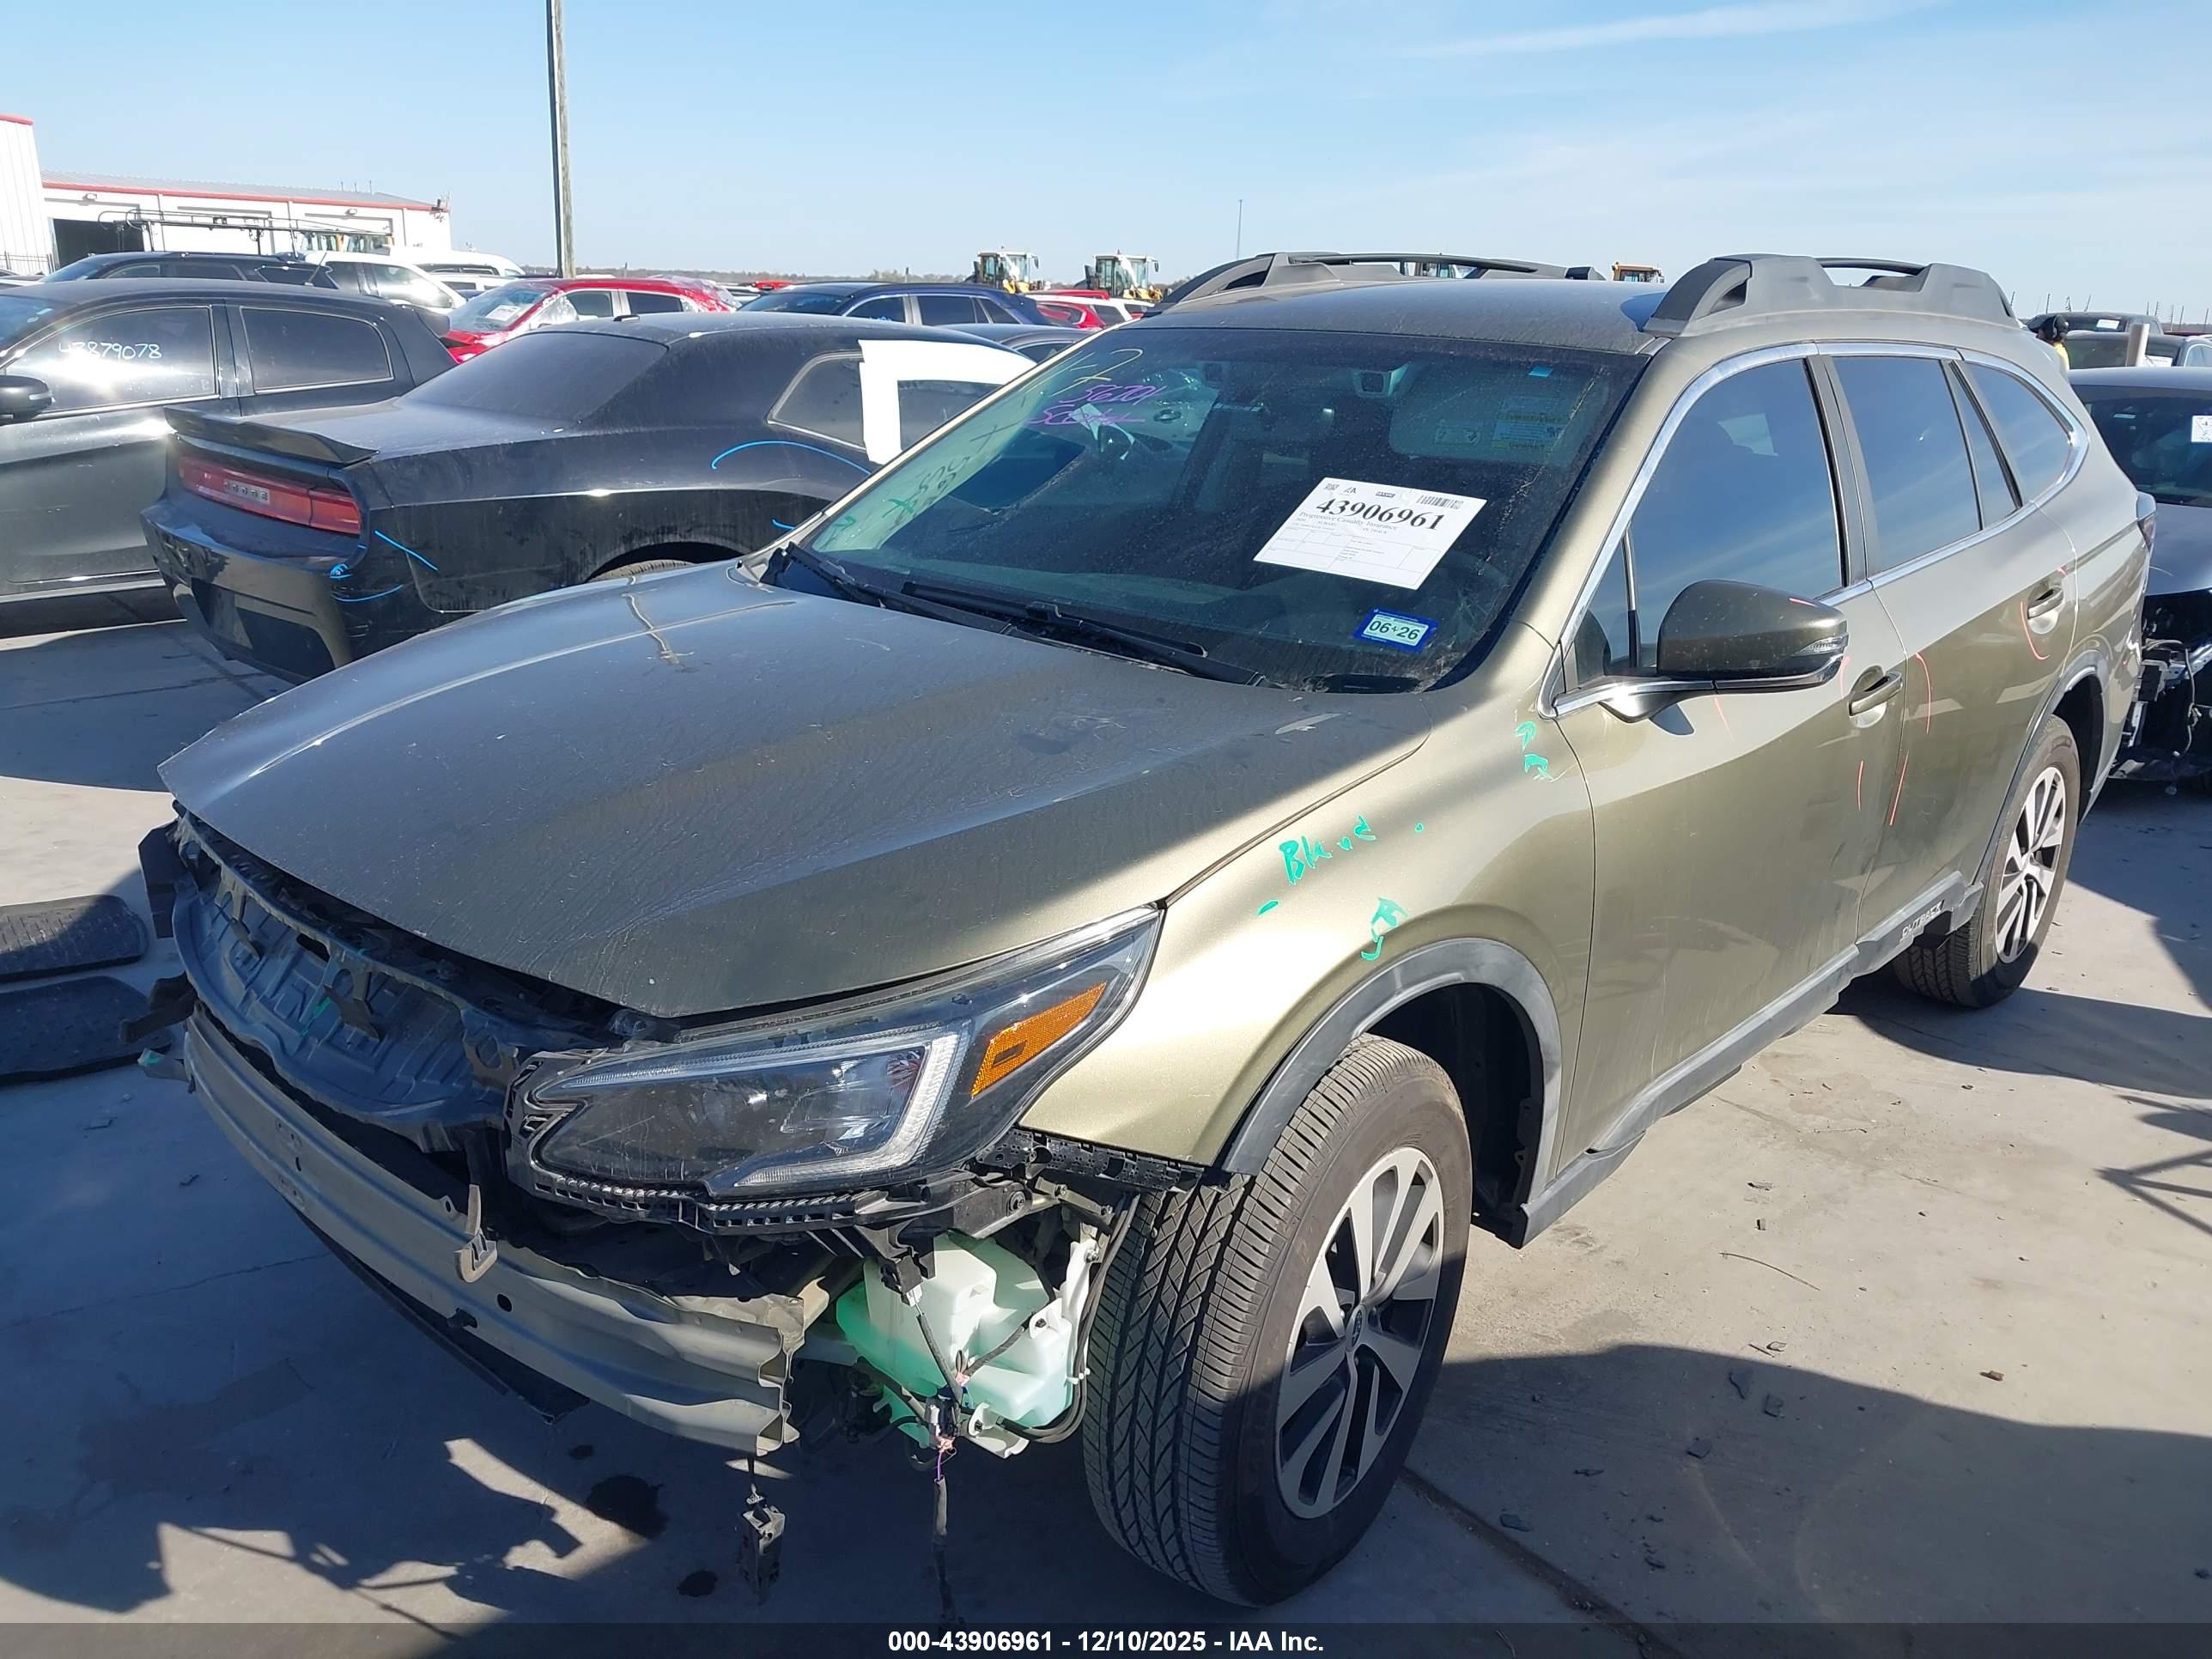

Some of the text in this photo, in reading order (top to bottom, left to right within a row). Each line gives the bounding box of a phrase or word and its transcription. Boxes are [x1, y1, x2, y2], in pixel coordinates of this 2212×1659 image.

[1299, 512, 1336, 522] Progressive
[1336, 517, 1364, 526] Casualty
[1364, 520, 1398, 532] Insurance
[1316, 498, 1444, 530] 43906961
